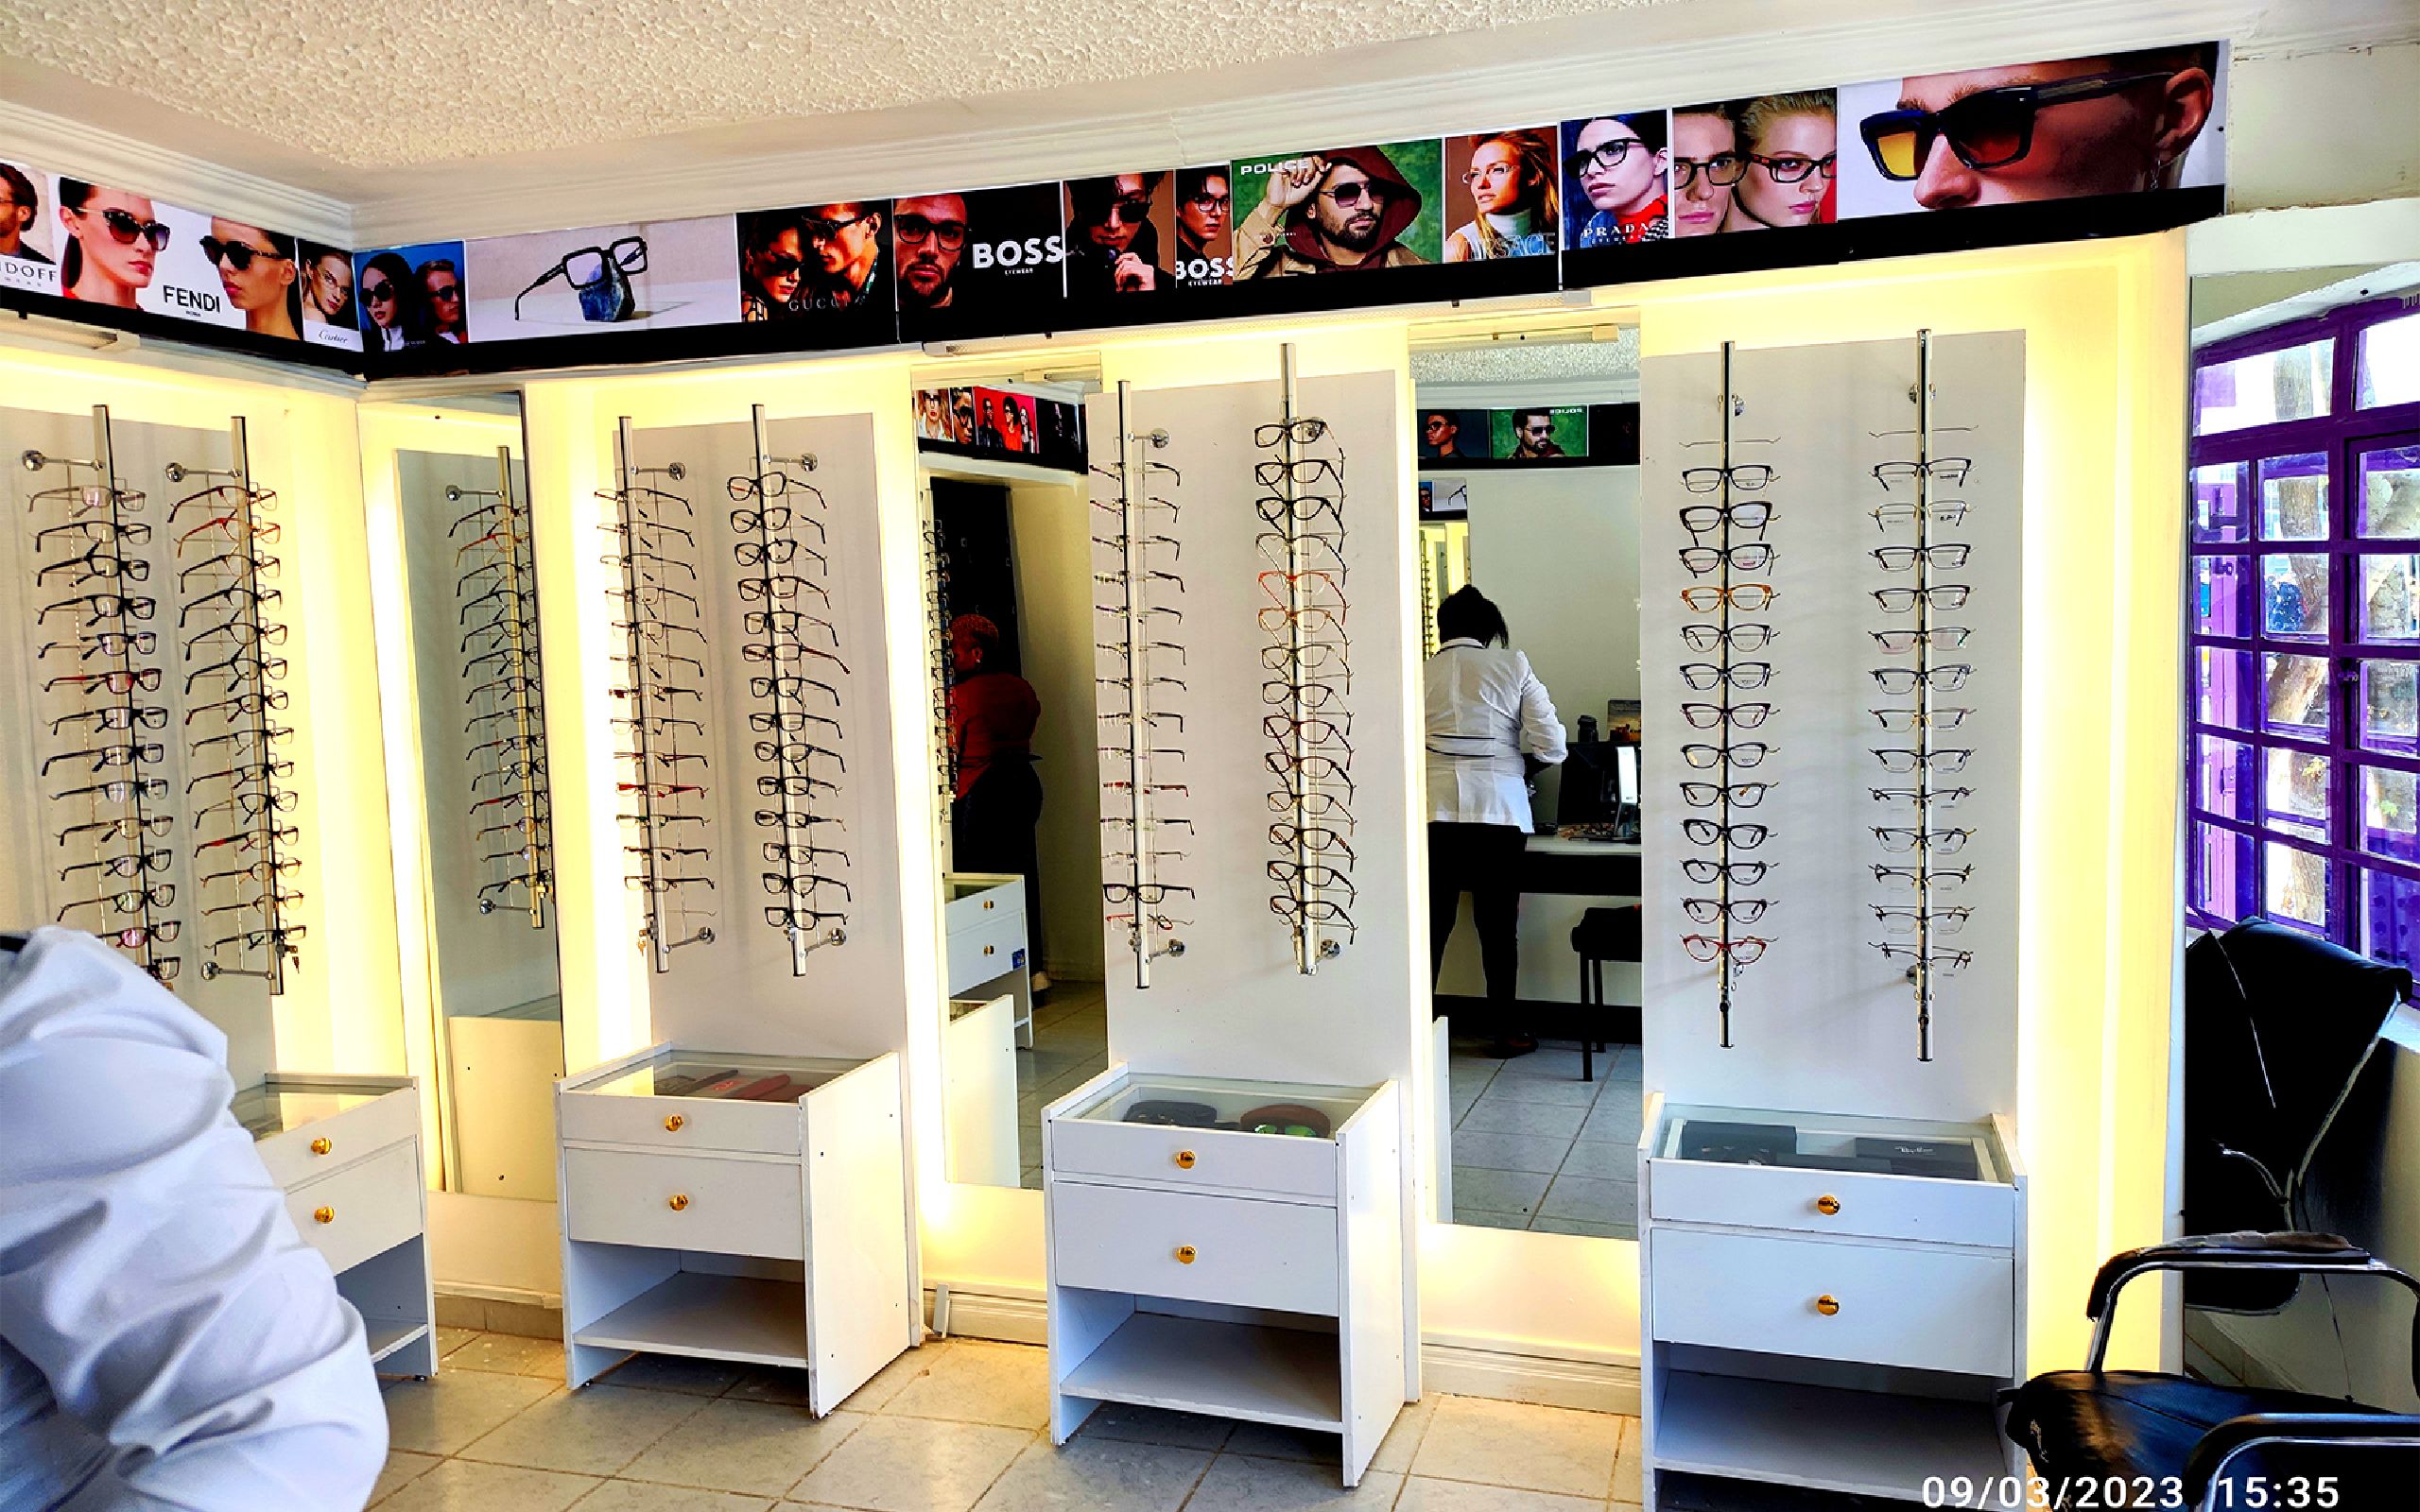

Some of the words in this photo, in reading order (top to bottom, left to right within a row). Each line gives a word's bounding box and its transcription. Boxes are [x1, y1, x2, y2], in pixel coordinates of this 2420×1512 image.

[1240, 158, 1308, 176] POLICE
[1583, 223, 1649, 237] PRADA
[973, 235, 1063, 269] BOSS
[0, 262, 57, 283] DOFF
[163, 284, 221, 314] FENDI
